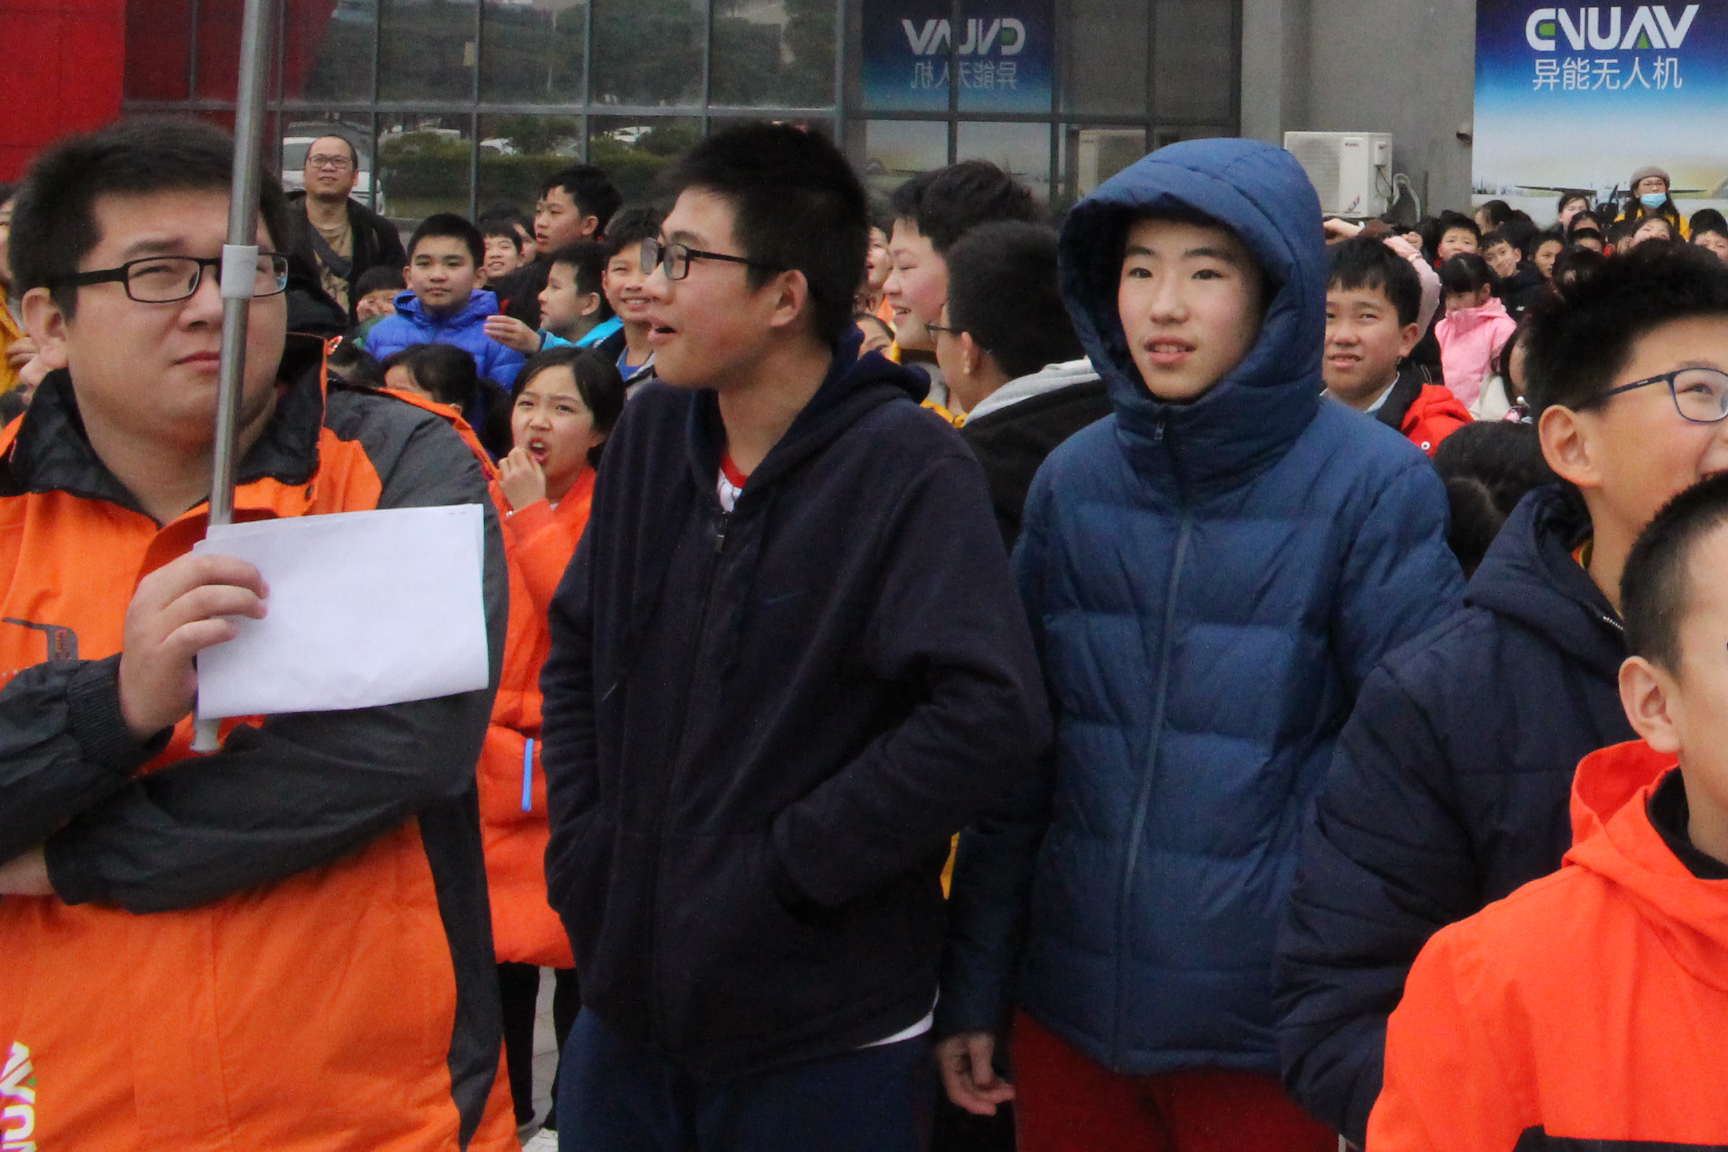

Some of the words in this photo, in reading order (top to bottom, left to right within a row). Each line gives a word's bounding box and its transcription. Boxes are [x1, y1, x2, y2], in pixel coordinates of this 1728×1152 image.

[1532, 54, 1683, 91] 异能无人机
